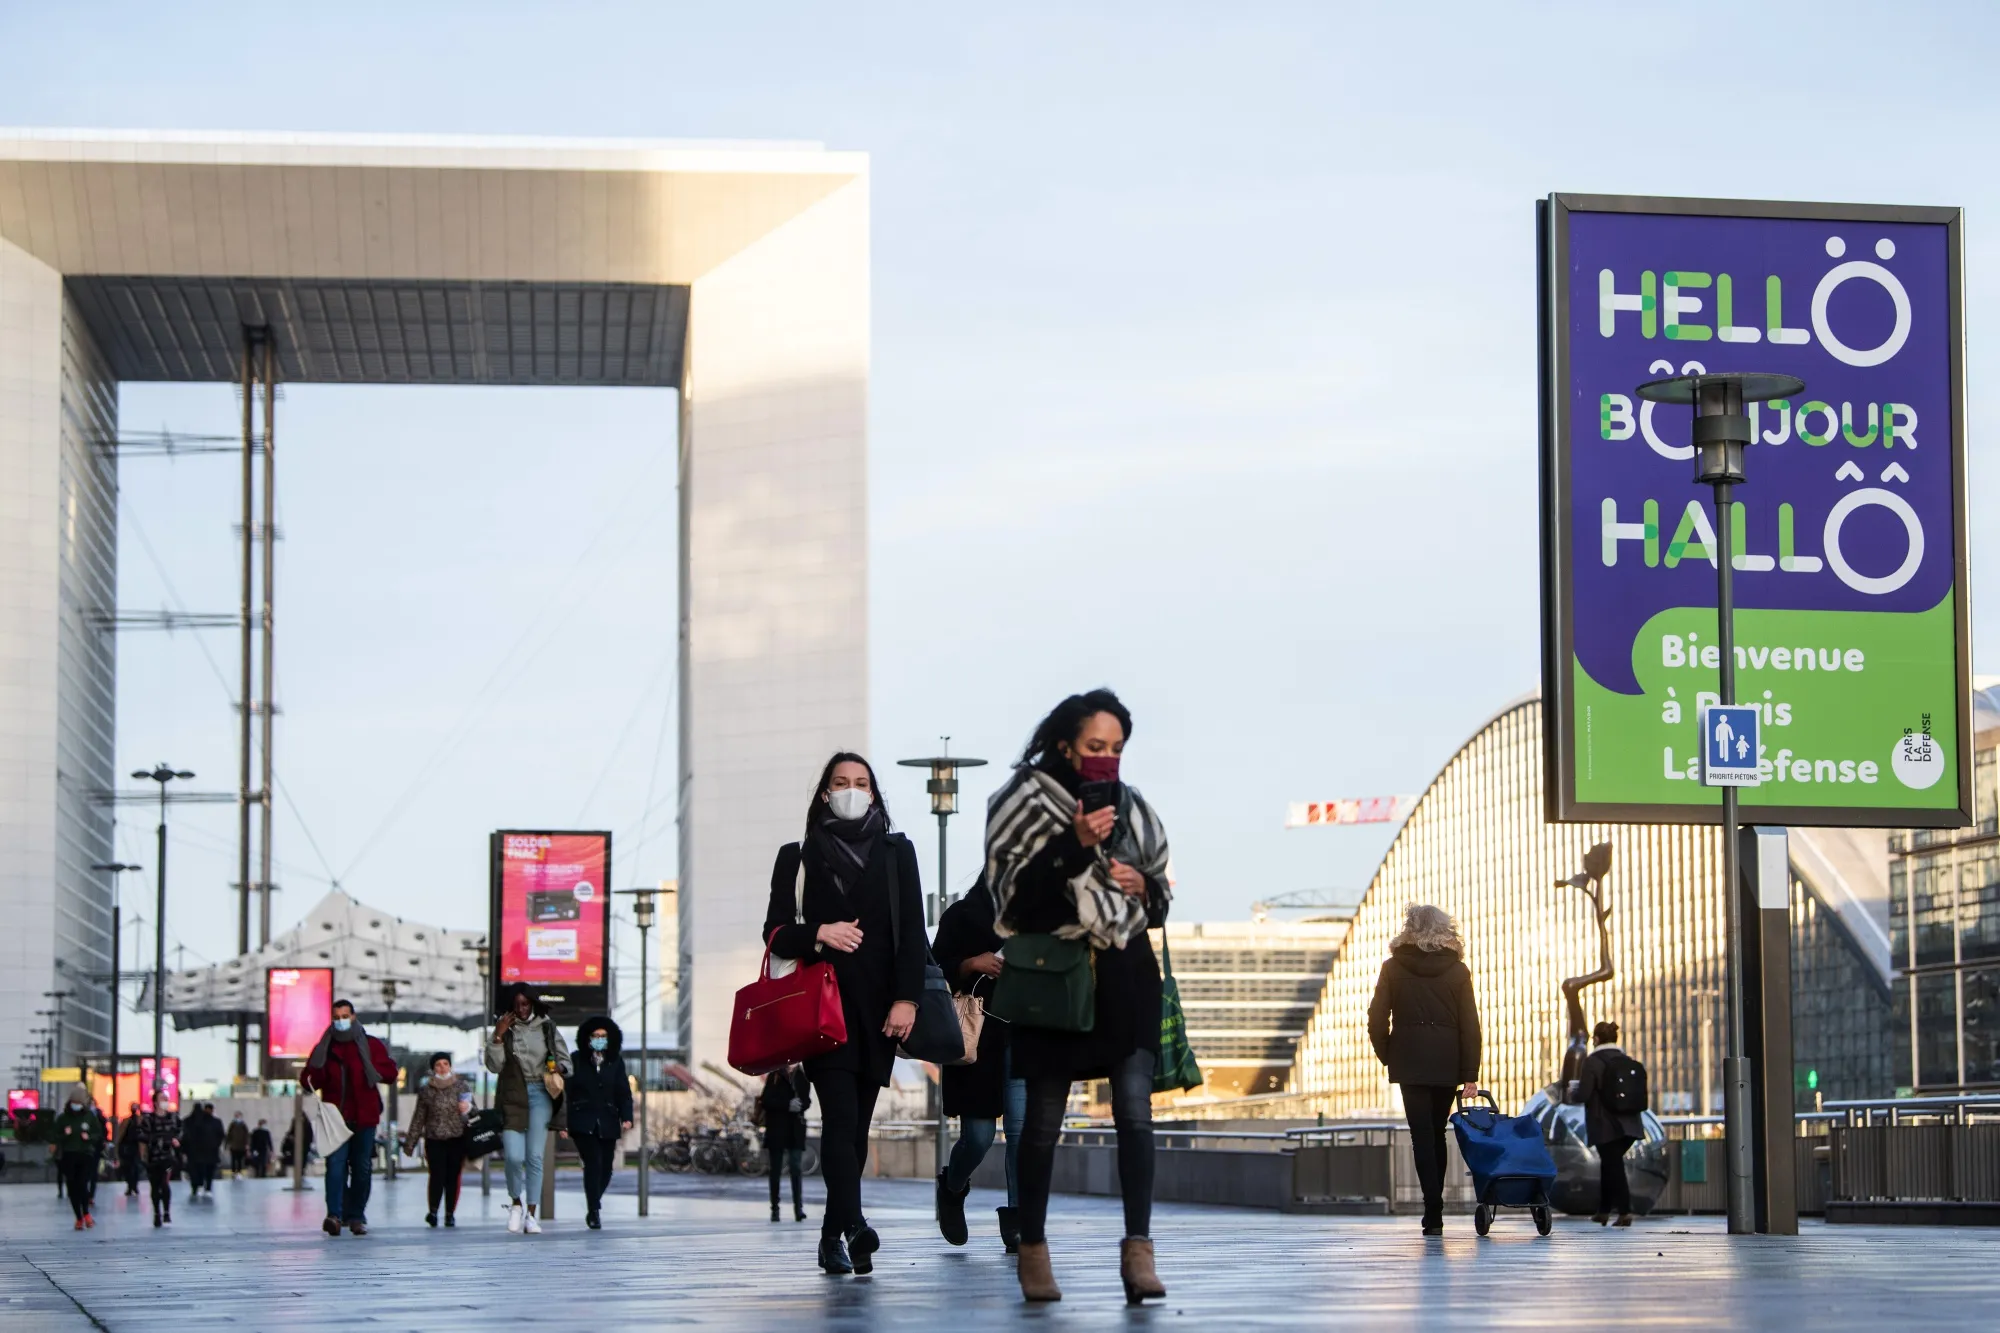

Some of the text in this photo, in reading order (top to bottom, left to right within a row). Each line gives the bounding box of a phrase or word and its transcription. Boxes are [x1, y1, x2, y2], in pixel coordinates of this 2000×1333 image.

[1599, 236, 1912, 367] HELLÖ
[1661, 686, 1682, 724] à
[1758, 744, 1879, 784] éfense
[1913, 746, 1922, 762] LA
[1709, 772, 1758, 781] PRIORITÉ PIÉTONS
